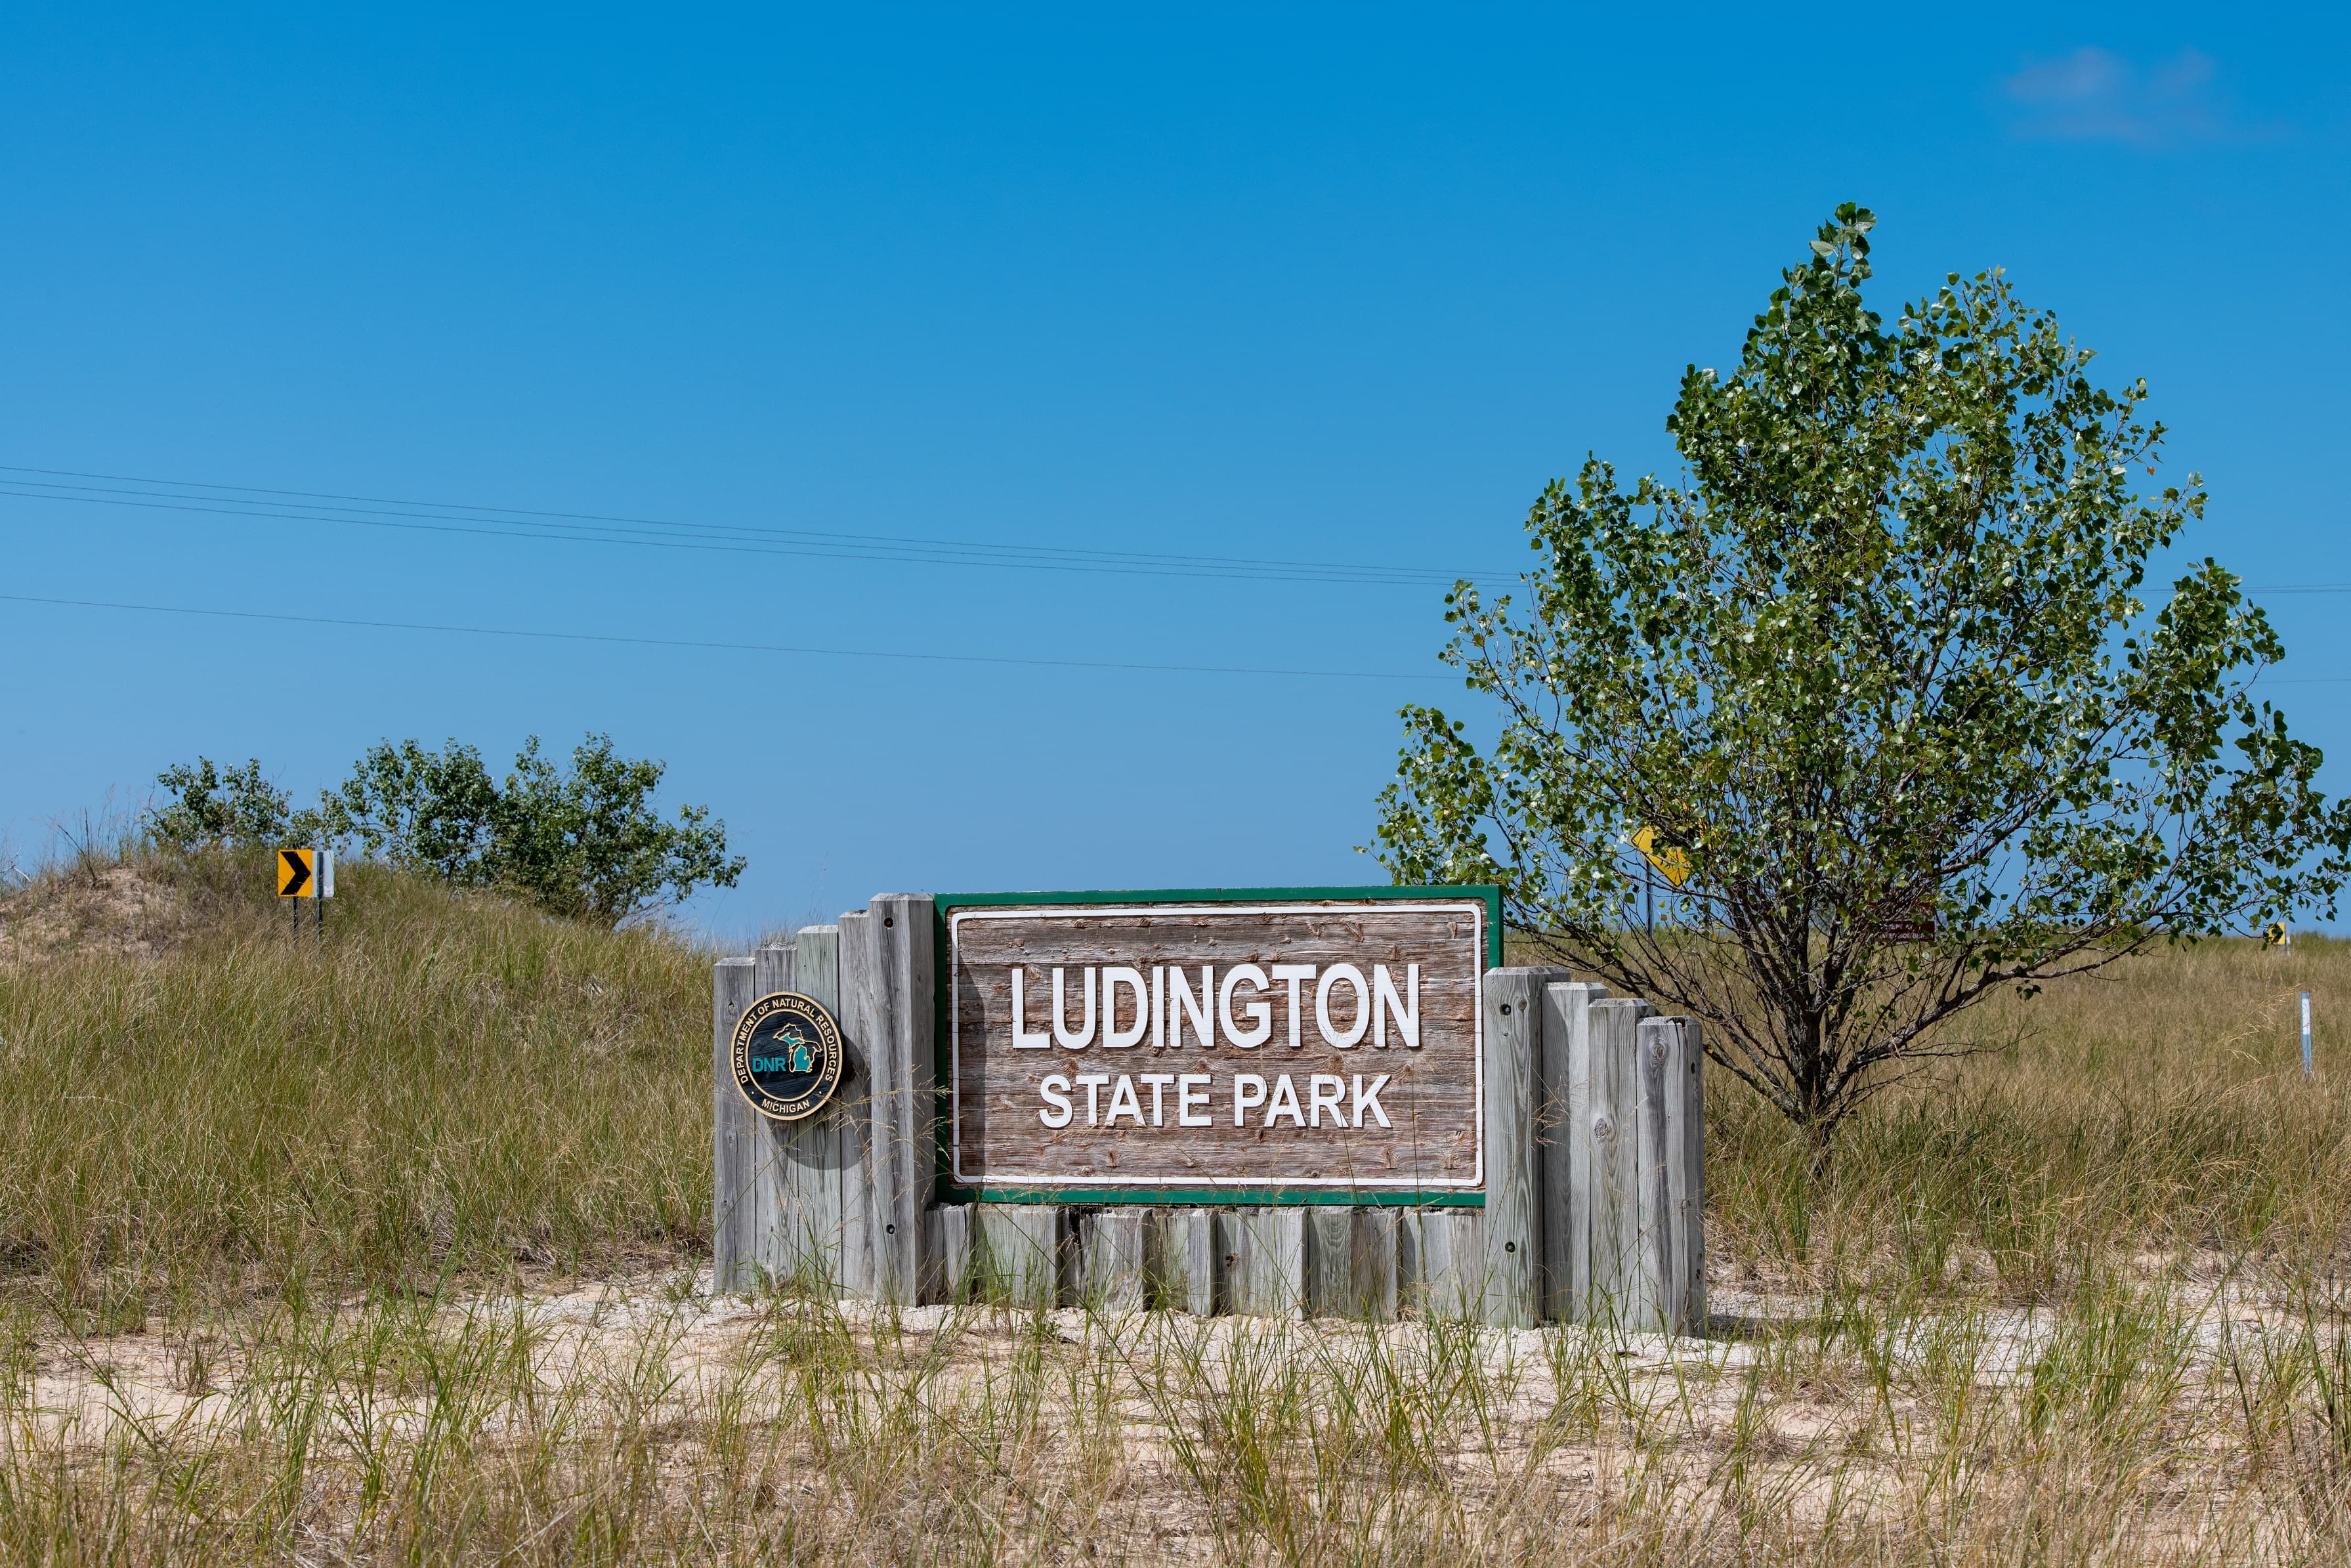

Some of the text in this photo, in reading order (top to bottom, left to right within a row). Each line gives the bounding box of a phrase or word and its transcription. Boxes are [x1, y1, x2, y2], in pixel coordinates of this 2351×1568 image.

[1011, 963, 1420, 1049] LUDINGTON
[736, 998, 837, 1084] DEPARTMENT OF NATURAL RESOURCES
[752, 1057, 786, 1072] DNR
[761, 1098, 811, 1113] MICHIGAN
[1038, 1073, 1393, 1128] STATE PARK
